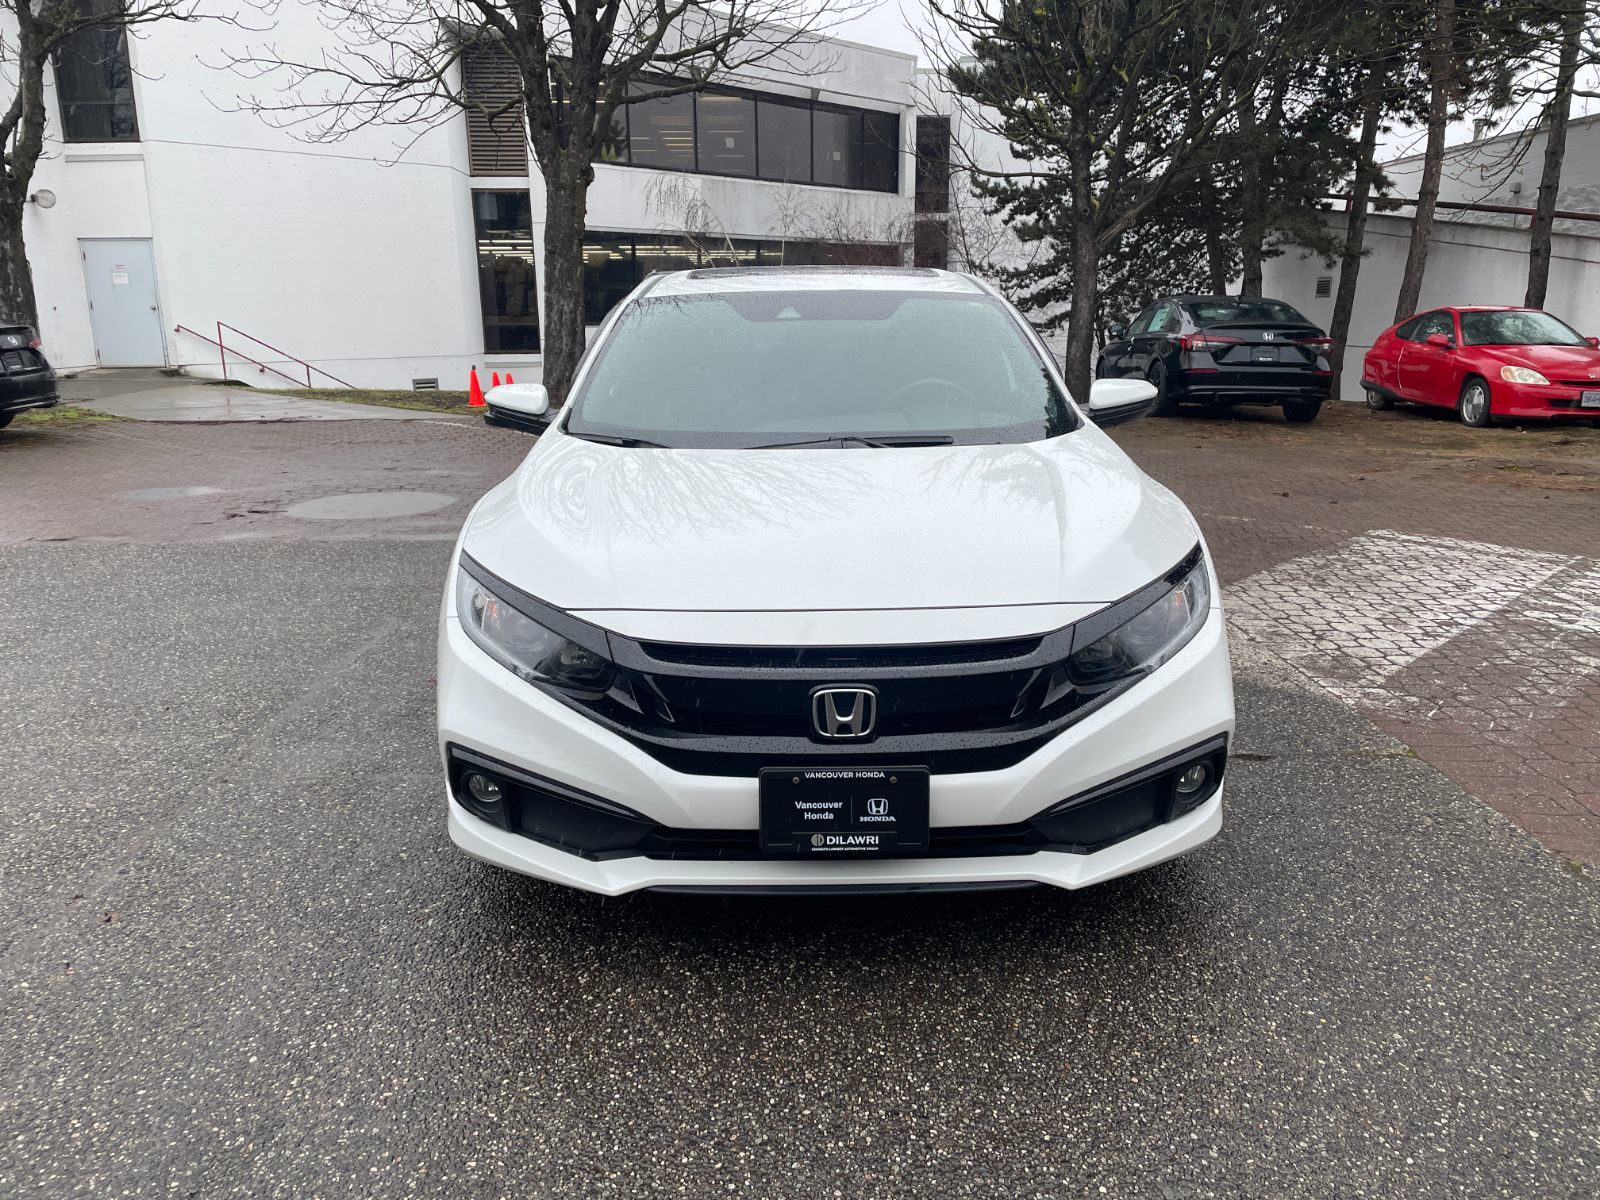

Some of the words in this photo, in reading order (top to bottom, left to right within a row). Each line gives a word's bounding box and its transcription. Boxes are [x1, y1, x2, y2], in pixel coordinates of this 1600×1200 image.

[804, 771, 854, 779] VANCOUVER
[855, 771, 886, 779] HONDA
[795, 801, 844, 810] Vancouver
[804, 811, 835, 820] Honda
[826, 835, 880, 845] DILAWRI
